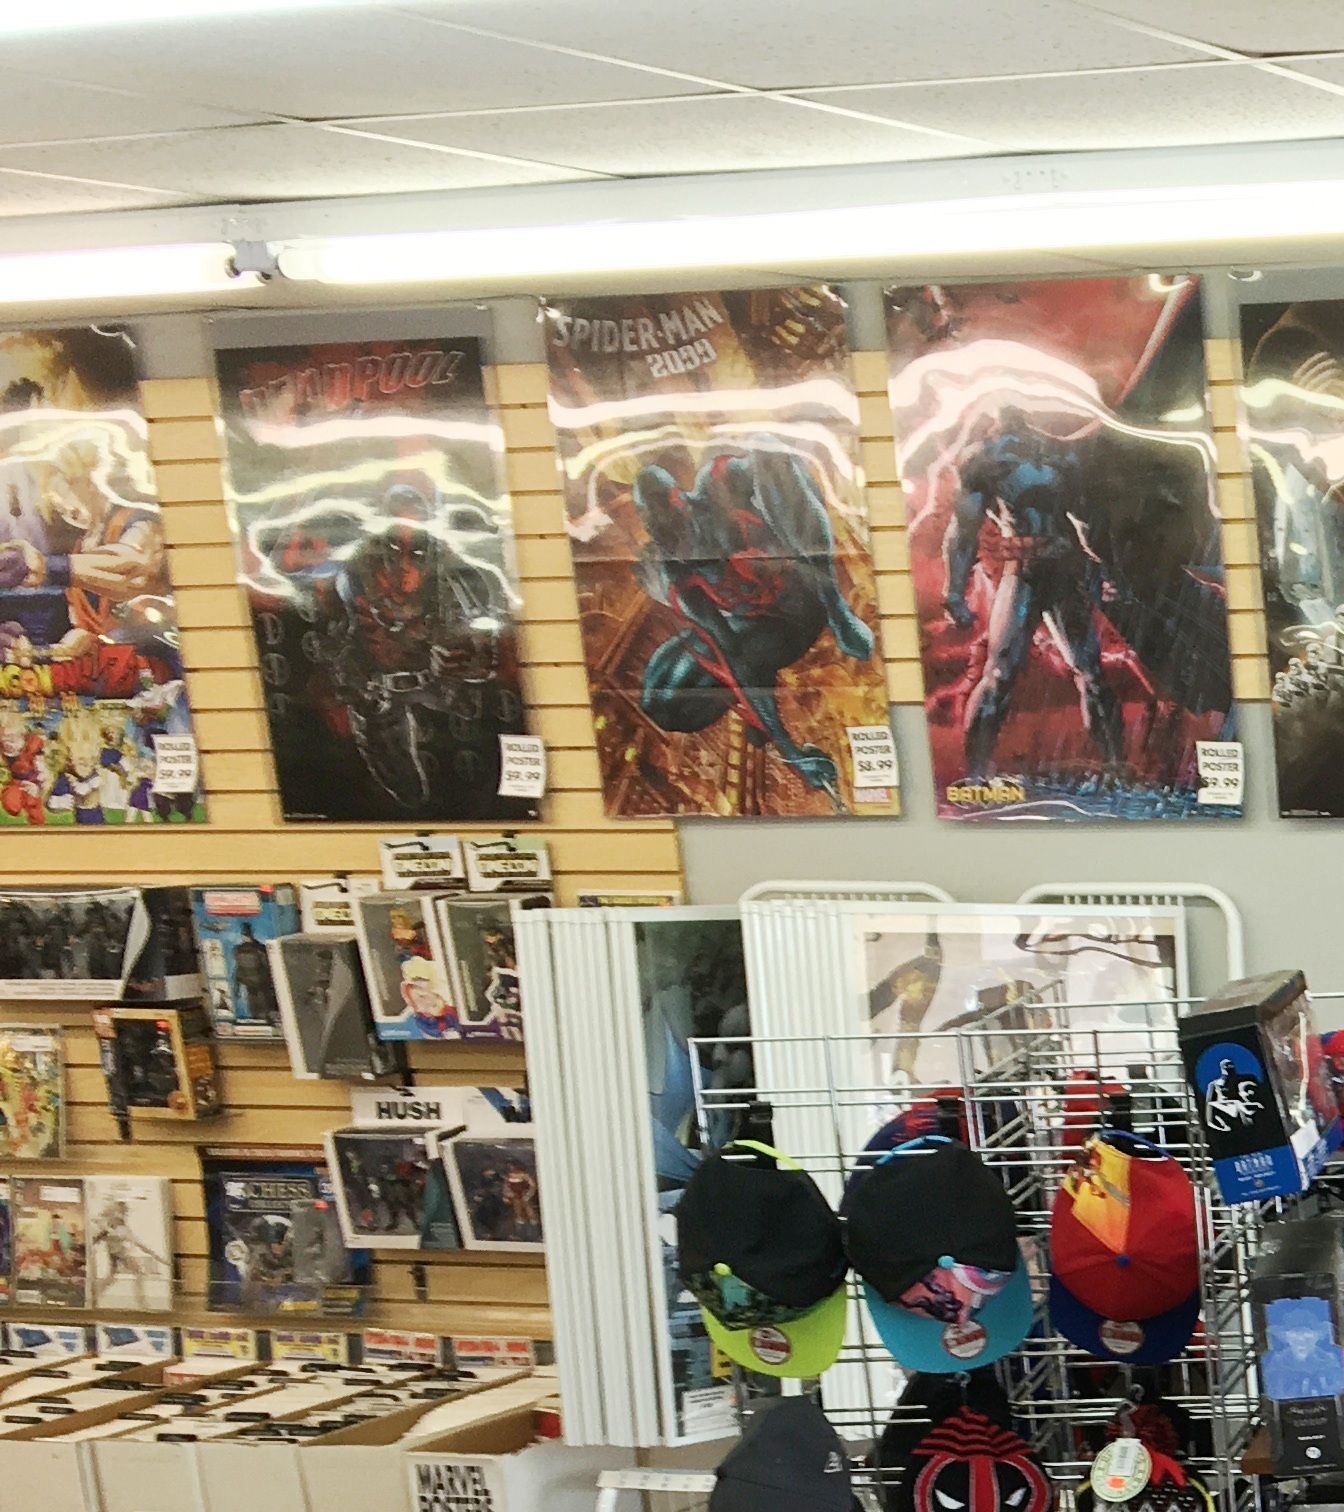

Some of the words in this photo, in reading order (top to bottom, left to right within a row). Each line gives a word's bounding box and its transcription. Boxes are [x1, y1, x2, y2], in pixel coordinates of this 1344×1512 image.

[645, 338, 718, 378] 2099
[852, 732, 888, 741] ROLLED
[159, 742, 191, 751] ROLLED
[504, 743, 539, 752] ROLLED
[856, 745, 892, 754] POSTER
[1201, 747, 1238, 757] ROLLED
[160, 755, 192, 764] POSTER
[506, 756, 540, 766] POSTER
[1203, 761, 1239, 772] POSTER
[1202, 777, 1240, 788] $9.99
[947, 785, 1026, 802] BATMAN
[376, 1101, 442, 1120] HUSH
[415, 1464, 490, 1496] MARVEL
